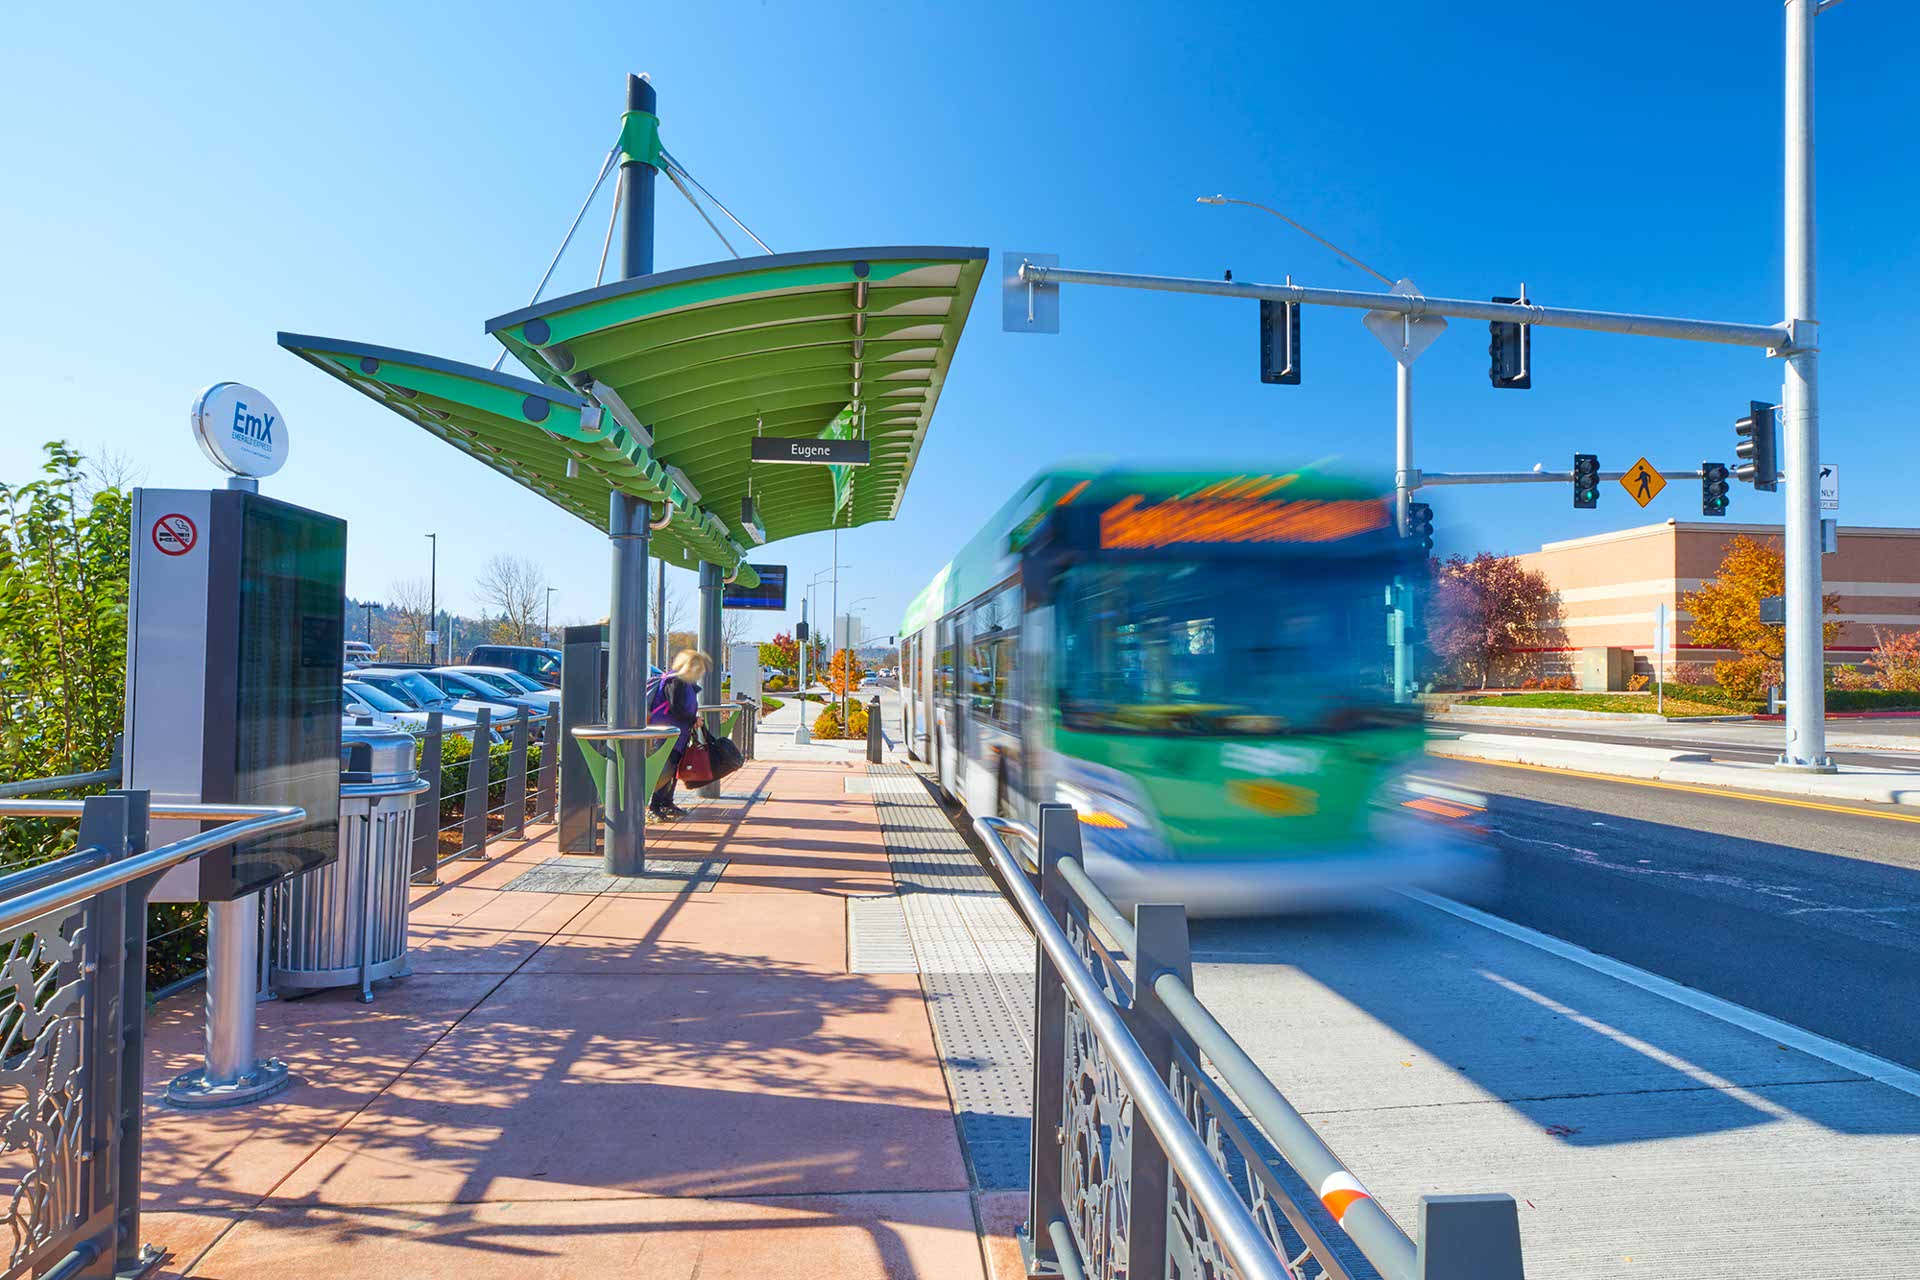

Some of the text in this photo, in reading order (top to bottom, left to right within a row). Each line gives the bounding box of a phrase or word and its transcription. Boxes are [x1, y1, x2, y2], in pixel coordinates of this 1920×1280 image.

[233, 401, 274, 444] EmX
[232, 431, 253, 446] EMERALD
[253, 440, 272, 453] EXPRESS
[791, 443, 831, 458] Eugene
[1821, 489, 1835, 497] NLY
